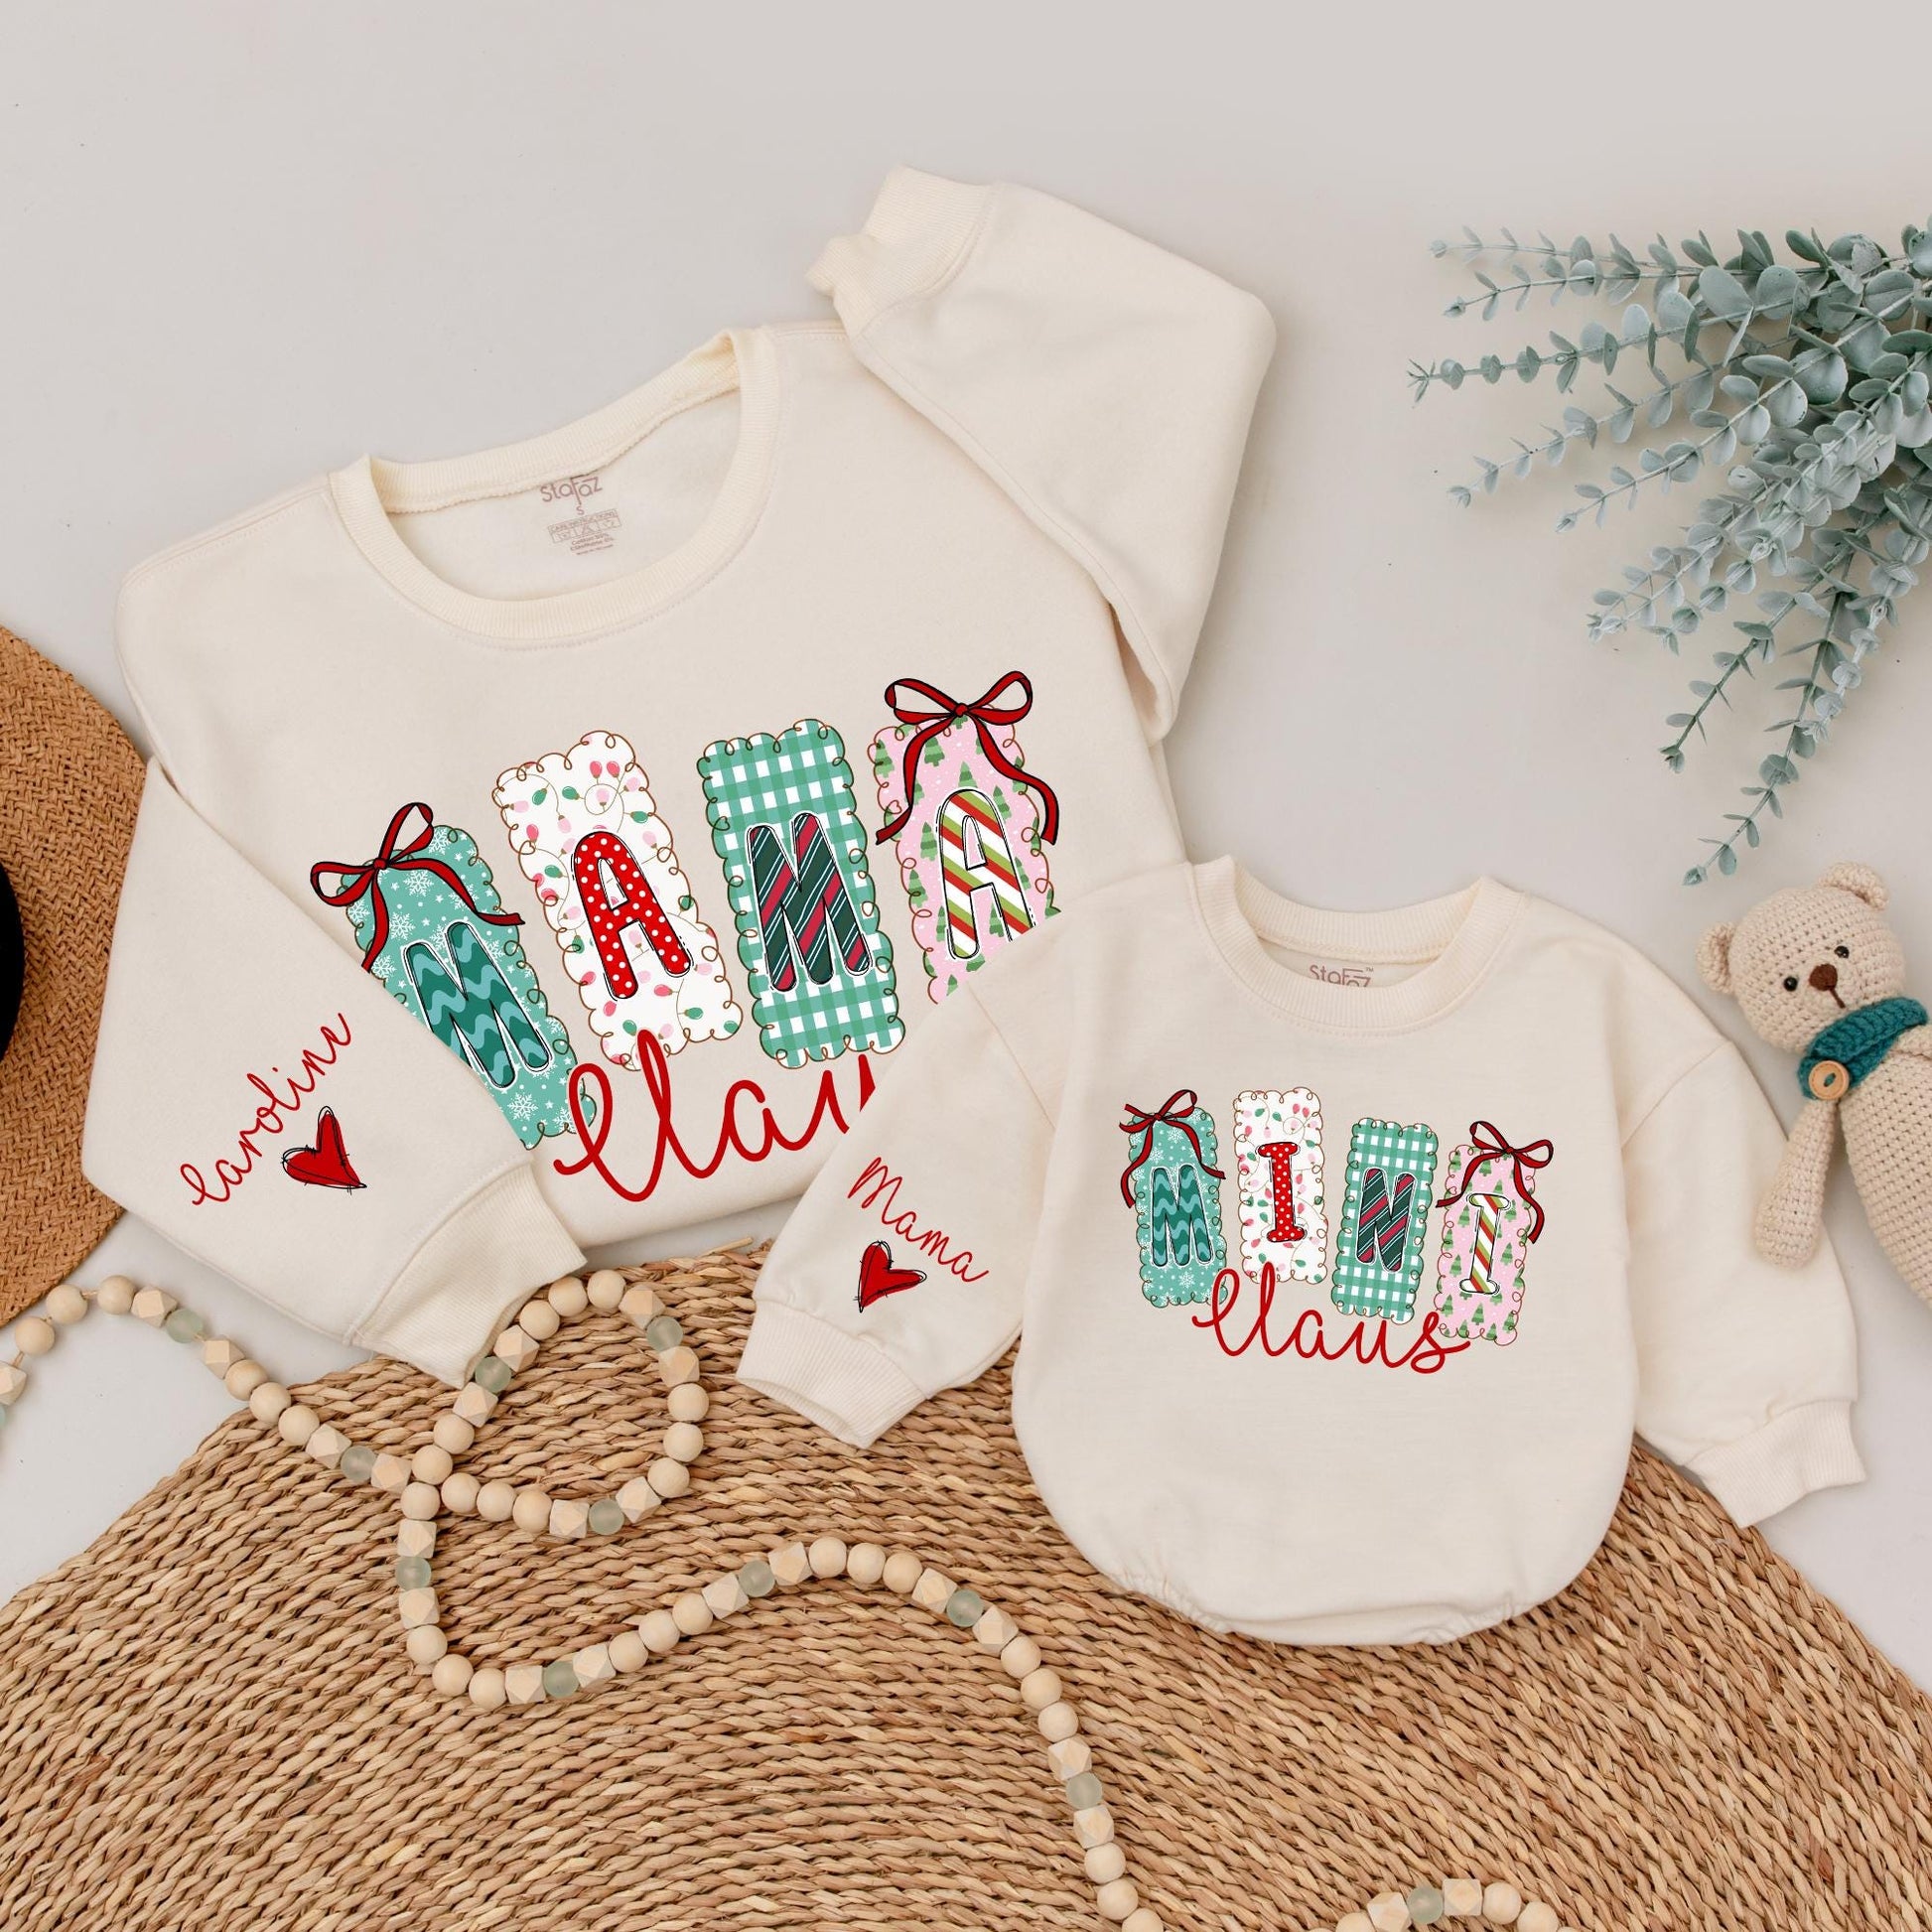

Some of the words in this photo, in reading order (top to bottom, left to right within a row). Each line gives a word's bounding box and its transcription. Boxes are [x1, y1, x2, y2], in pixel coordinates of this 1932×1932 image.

[576, 505, 585, 515] S
[402, 788, 1037, 1090] MAMA
[847, 1157, 989, 1283] Mama
[1150, 1142, 1511, 1296] MINI
